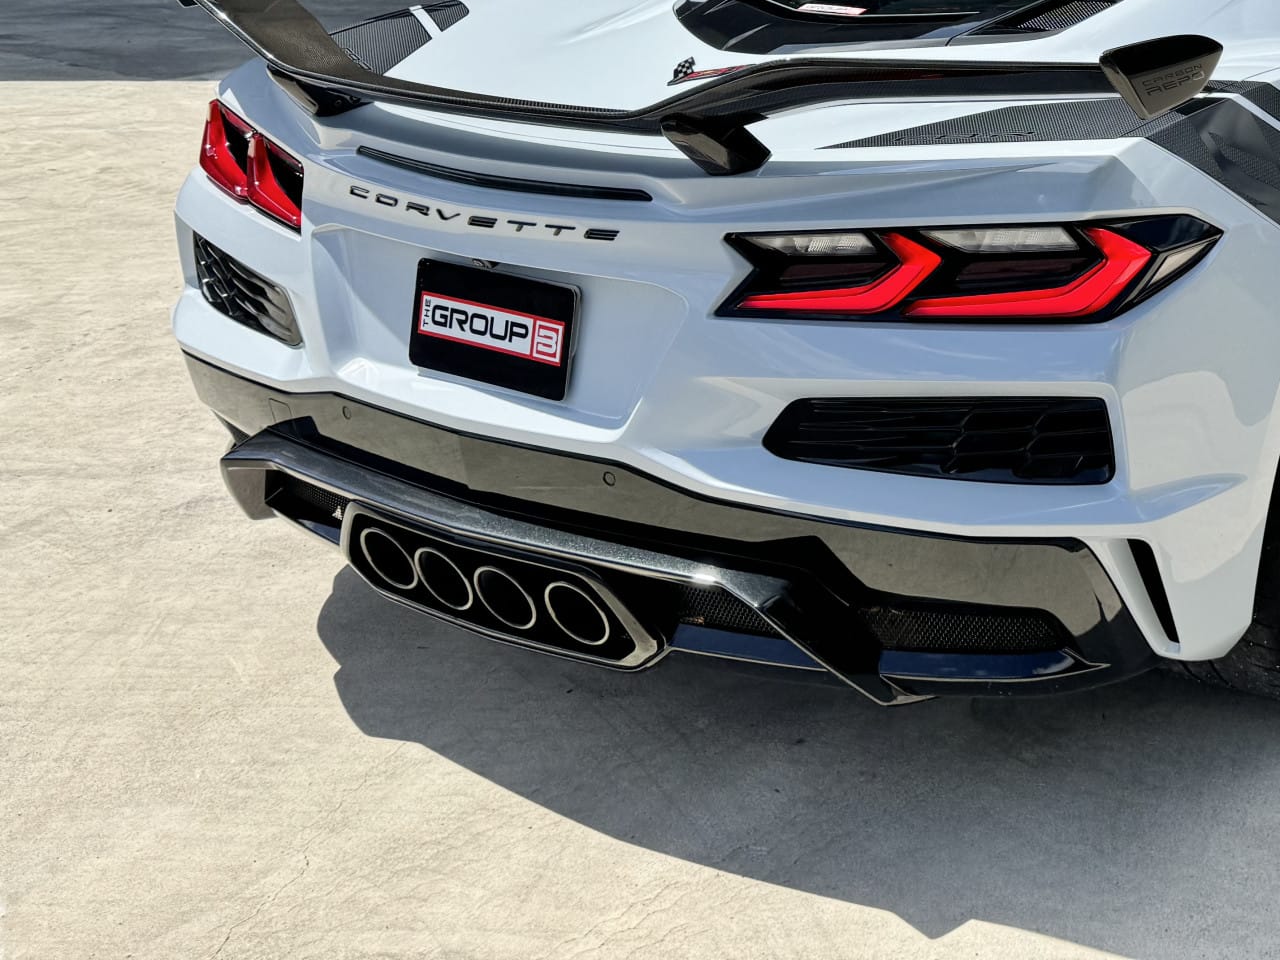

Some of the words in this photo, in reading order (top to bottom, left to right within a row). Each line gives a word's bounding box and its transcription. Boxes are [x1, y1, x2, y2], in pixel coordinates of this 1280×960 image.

[349, 185, 620, 241] CORVETTE
[422, 298, 432, 328] THE
[431, 304, 529, 343] GROUP
